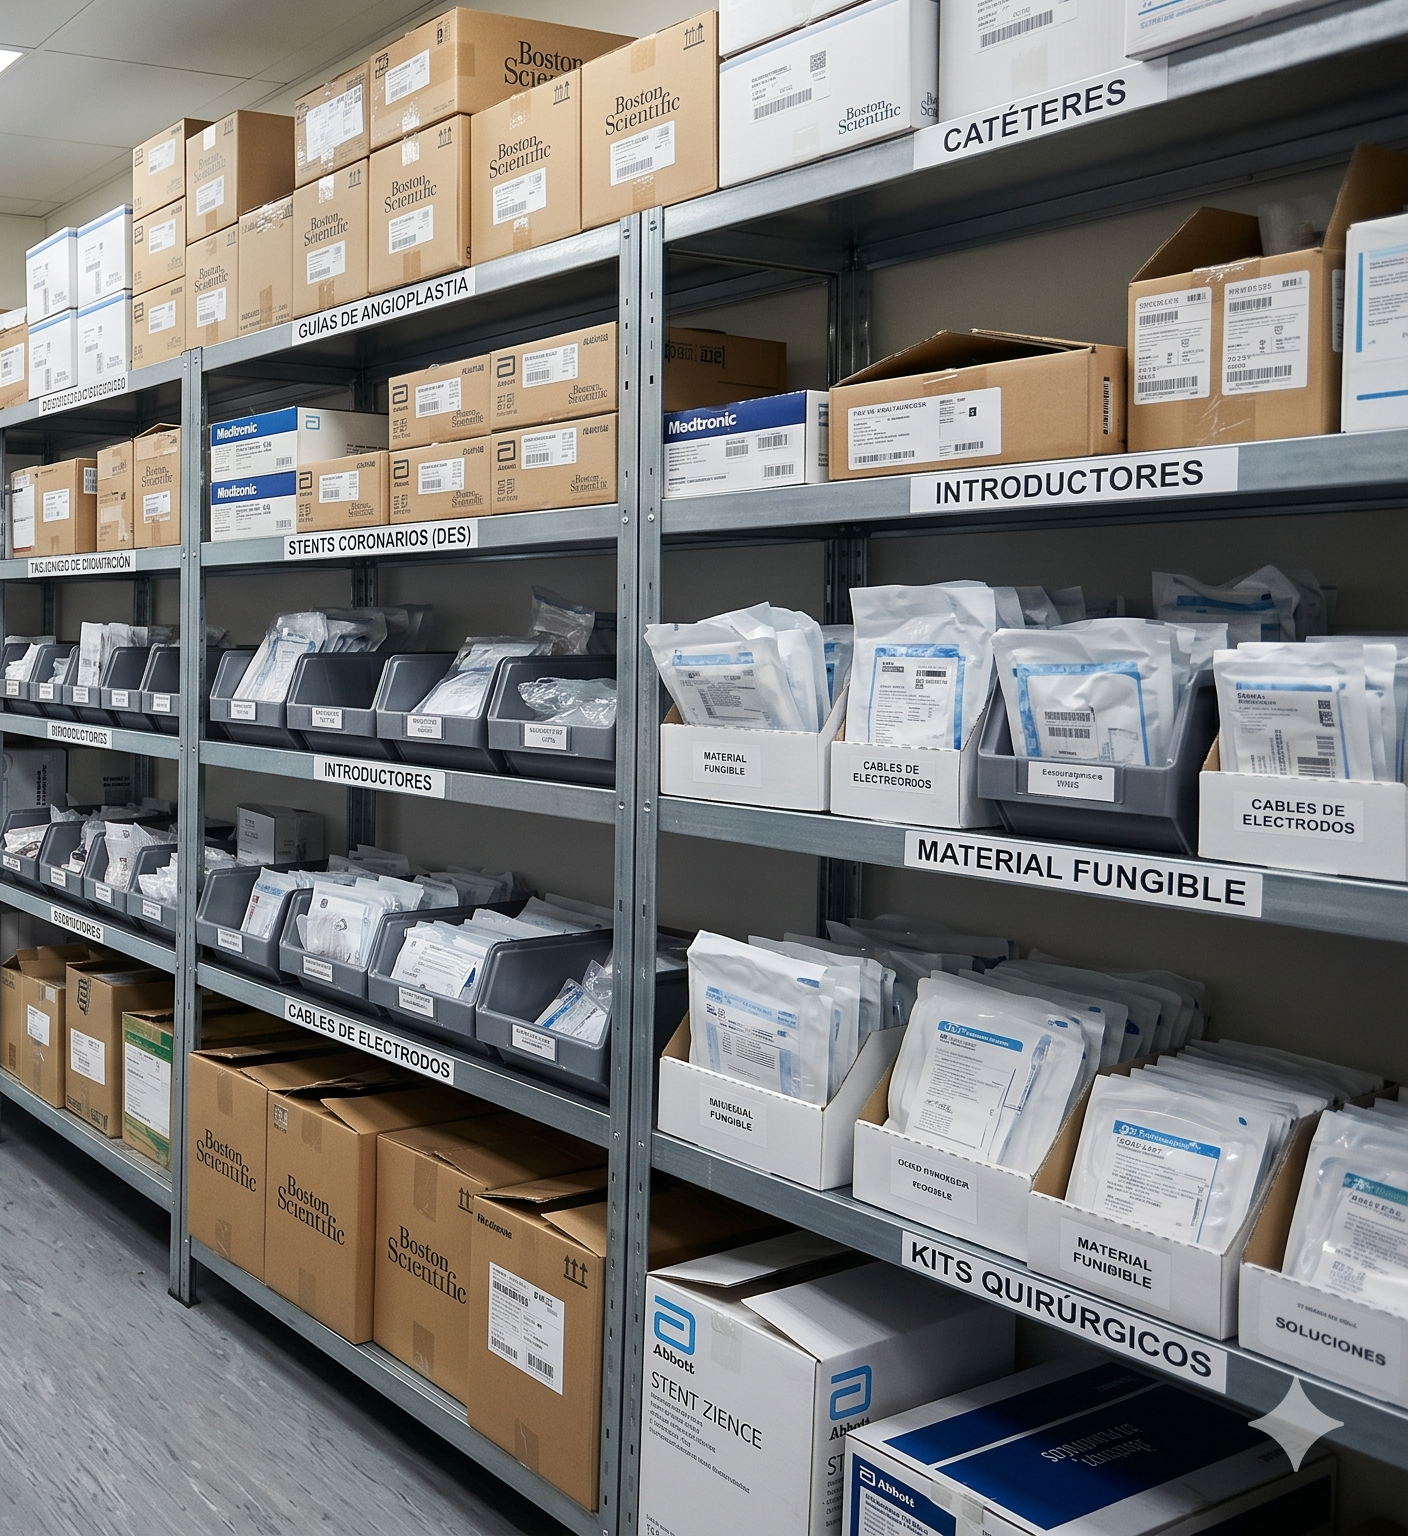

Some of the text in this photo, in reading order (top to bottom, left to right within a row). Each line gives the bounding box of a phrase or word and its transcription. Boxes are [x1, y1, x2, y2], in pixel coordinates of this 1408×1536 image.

[518, 40, 583, 71] Boston
[605, 92, 681, 136] Scientific
[615, 86, 663, 116] Boston
[846, 100, 885, 121] Boston
[943, 79, 1126, 153] CATÉTERES
[838, 103, 901, 135] Scientific
[489, 140, 551, 179] Scientific
[498, 135, 537, 160] Boston
[384, 179, 437, 213] Scientific
[391, 174, 426, 197] Boston
[304, 217, 348, 246] Scientific
[311, 212, 339, 230] Boston
[298, 316, 337, 339] GUÍAS
[341, 305, 358, 329] DE
[935, 459, 1204, 505] INTRODUCTORES
[288, 526, 472, 556] STENTS CORONARIOS (DES)
[703, 752, 747, 763] MATERIAL
[704, 764, 745, 776] FUNGIBLE
[863, 761, 919, 775] CABLES DE
[324, 762, 432, 791] INTRODUCTORES
[1243, 814, 1355, 834] ELECTRODOS
[1251, 799, 1345, 817] CABLES DE
[918, 839, 1246, 906] MATERIAL FUNGIBLE
[288, 1004, 450, 1078] CABLES DE ELECTRODOS
[205, 1128, 243, 1168] Boston
[196, 1140, 257, 1193] Scientific
[287, 1174, 330, 1216] Boston
[278, 1186, 345, 1246] Scientific
[399, 1225, 449, 1272] Boston
[1077, 1237, 1152, 1272] MATERIAL
[388, 1236, 467, 1305] Scientific
[911, 1241, 1212, 1378] KITS QUIRÚRGICOS
[1276, 1317, 1386, 1366] SOLUCIONES
[653, 1343, 695, 1375] Abbott
[651, 1371, 699, 1411] STENT
[702, 1398, 763, 1450] ZIENCE
[877, 1479, 915, 1509] Abbott
